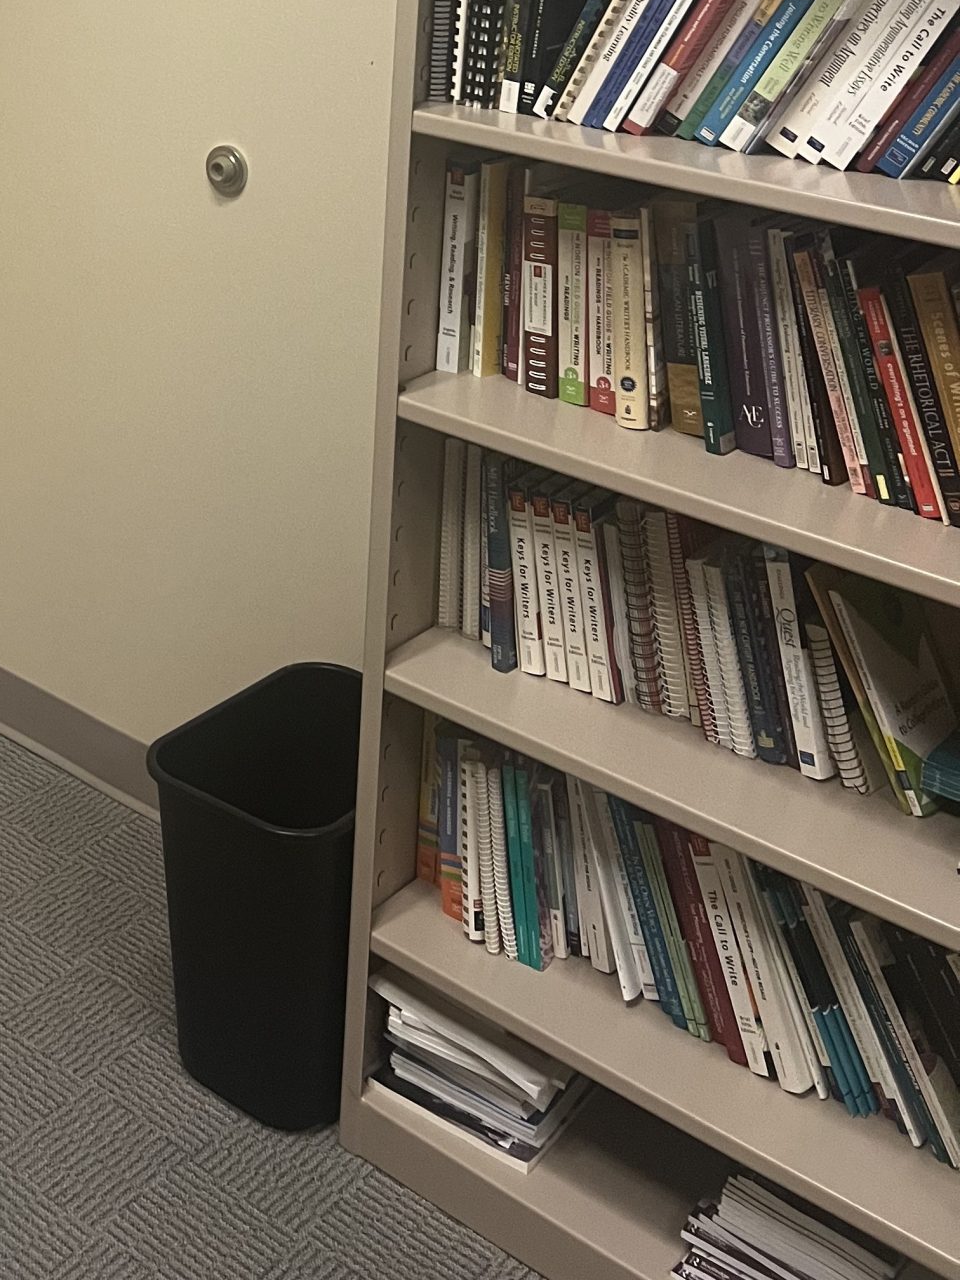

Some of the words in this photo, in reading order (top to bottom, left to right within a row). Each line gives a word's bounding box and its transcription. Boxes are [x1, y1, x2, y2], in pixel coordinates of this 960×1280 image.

[775, 2, 798, 31] Joining
[818, 1, 830, 14] to
[926, 5, 948, 30] The
[602, 24, 629, 64] Learning
[768, 28, 781, 42] the
[792, 11, 825, 52] Writing
[847, 32, 862, 47] on
[863, 15, 910, 77] Argumentative
[911, 26, 932, 52] Call
[740, 39, 774, 86] Conversation
[778, 47, 801, 74] Well
[818, 42, 857, 91] Argument
[901, 49, 916, 65] to
[845, 68, 873, 99] Essays
[879, 61, 906, 95] Write
[450, 214, 459, 243] Writing,
[449, 243, 457, 273] Reading,
[447, 283, 455, 314] Research
[696, 290, 707, 325] DESIGNING
[675, 313, 685, 358] LITERATURE
[700, 326, 709, 349] VISUAL
[765, 312, 775, 358] PROFESSOR'S
[901, 324, 921, 353] THE
[930, 310, 951, 359] Scenes
[944, 361, 957, 377] of
[703, 350, 713, 385] LANGUAGE
[816, 330, 839, 393] CONVERSATION
[862, 346, 880, 391] WORLD
[773, 384, 779, 395] TO
[885, 361, 905, 408] everything's
[907, 351, 944, 437] RHETORICAL
[774, 396, 783, 428] SUCCESS
[899, 408, 907, 418] an
[901, 418, 918, 456] argument
[932, 437, 952, 467] ACT
[487, 490, 501, 533] Handbook
[516, 537, 526, 561] Keys
[541, 543, 551, 567] Keys
[561, 550, 571, 574] Keys
[520, 564, 529, 580] for
[544, 569, 555, 585] for
[565, 577, 574, 593] for
[583, 558, 593, 583] Keys
[520, 580, 531, 619] Writers
[547, 586, 556, 625] Writers
[586, 585, 597, 602] for
[567, 594, 577, 634] Writers
[588, 602, 599, 643] Writers
[777, 604, 800, 650] Quest
[794, 653, 804, 681] Reading
[799, 693, 809, 715] World
[792, 696, 802, 723] Change
[708, 888, 721, 910] The
[714, 912, 728, 936] Call
[721, 937, 732, 951] to
[724, 953, 742, 987] Write
